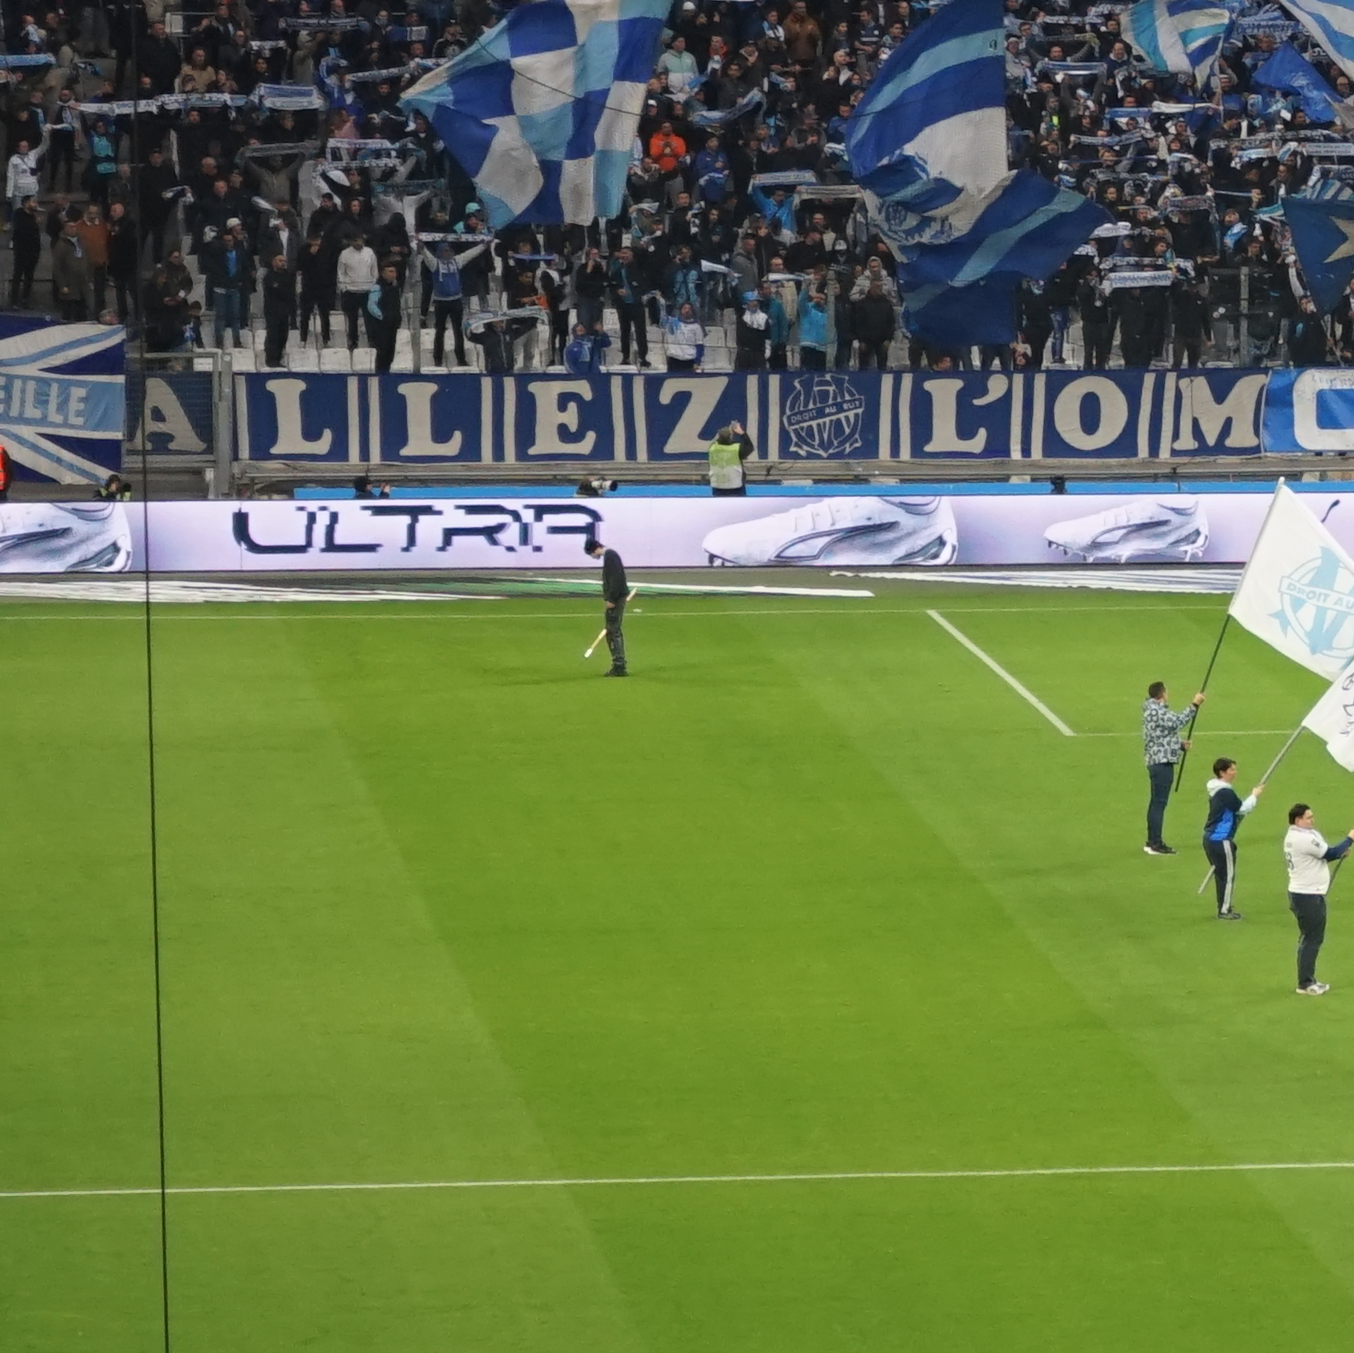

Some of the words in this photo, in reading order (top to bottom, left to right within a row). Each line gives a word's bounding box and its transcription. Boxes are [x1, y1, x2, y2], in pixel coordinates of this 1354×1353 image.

[135, 377, 730, 457] ALLEZ
[923, 373, 1267, 453] L'OM
[232, 503, 605, 555] ULTRA
[1287, 582, 1331, 606] DROIT
